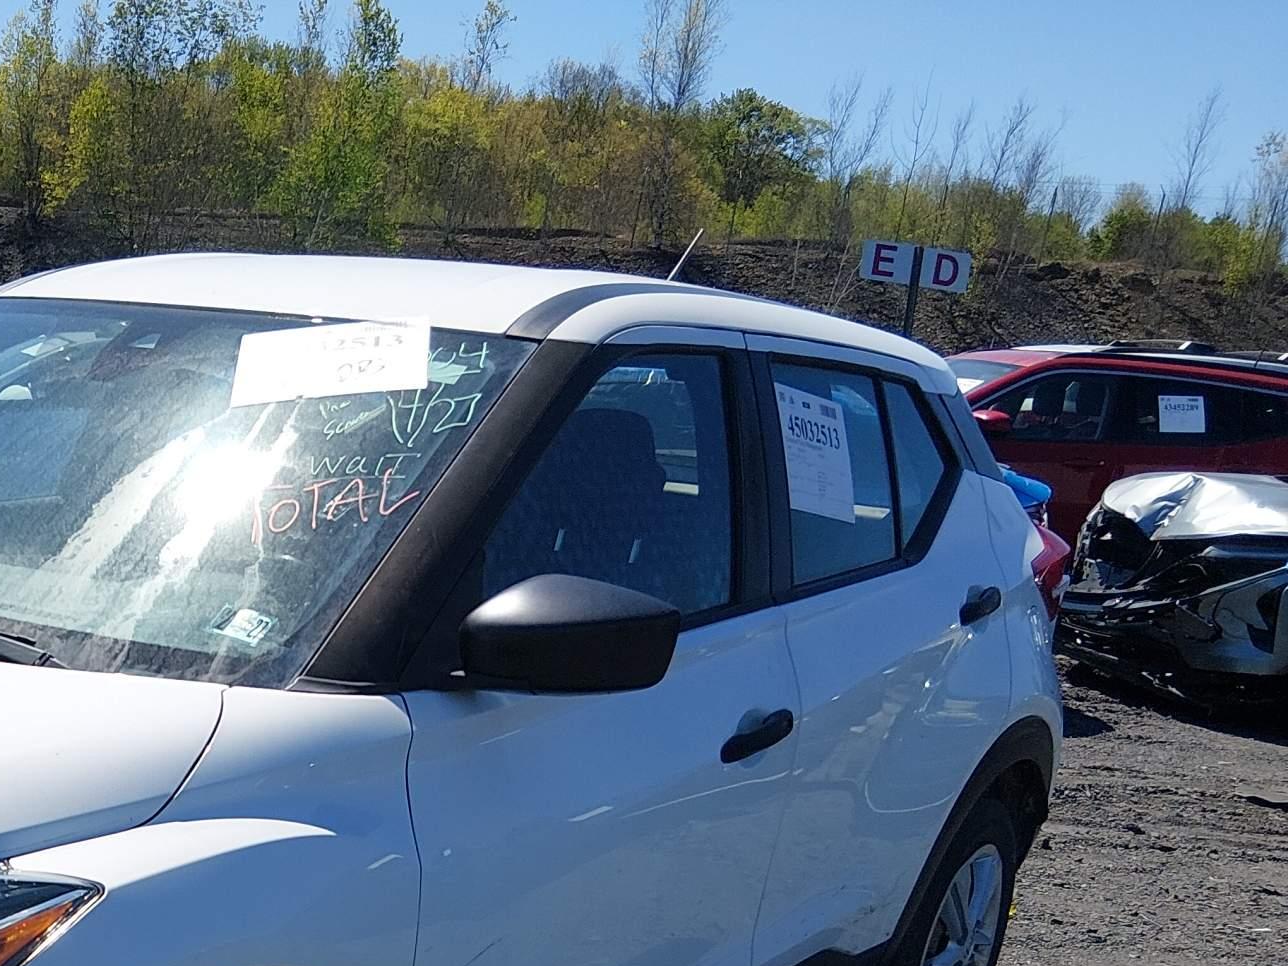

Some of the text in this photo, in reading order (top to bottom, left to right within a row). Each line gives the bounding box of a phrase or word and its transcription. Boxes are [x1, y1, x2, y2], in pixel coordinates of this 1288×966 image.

[871, 243, 898, 278] E
[932, 253, 960, 287] D
[787, 414, 840, 450] 45032513
